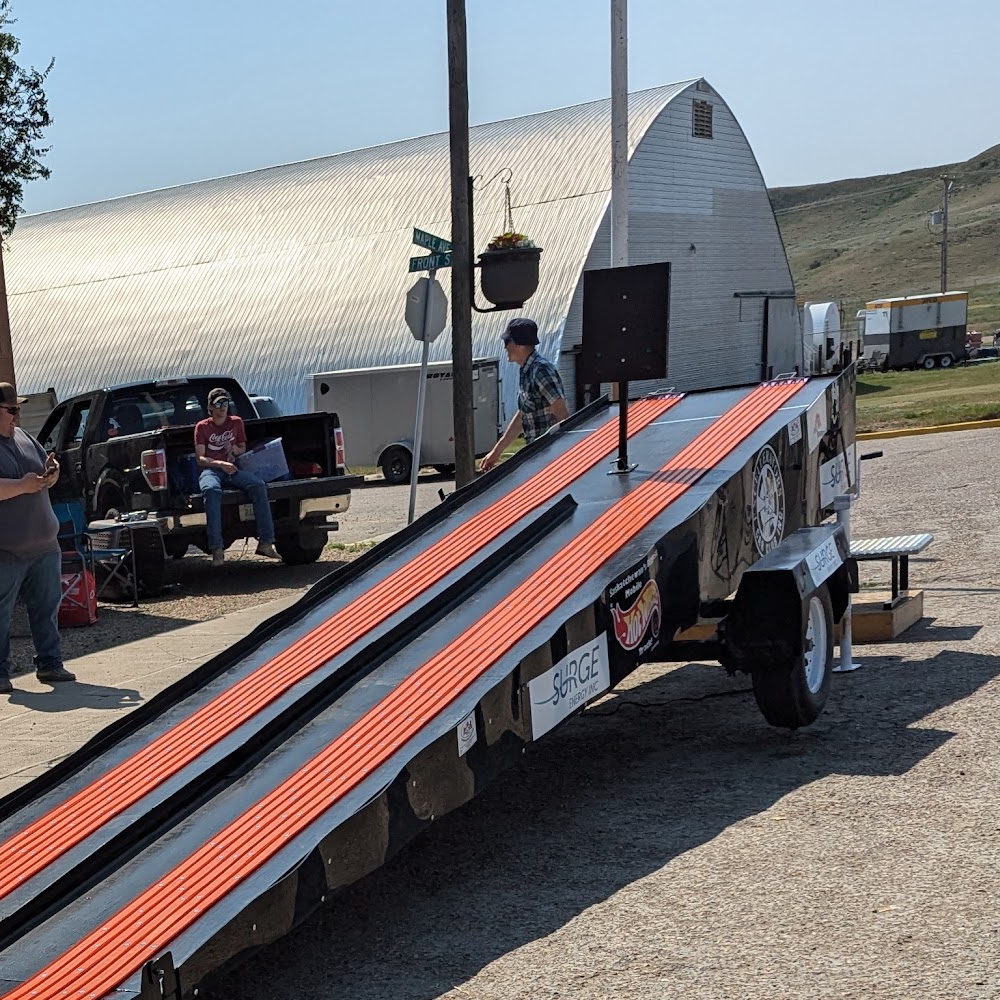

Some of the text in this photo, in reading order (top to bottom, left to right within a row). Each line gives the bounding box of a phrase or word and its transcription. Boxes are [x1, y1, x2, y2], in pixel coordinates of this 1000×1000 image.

[414, 231, 451, 253] MAPLE AVE
[411, 255, 441, 270] FRONT
[426, 372, 453, 380] ROYA
[552, 645, 600, 706] SURGE
[568, 680, 599, 709] ENERGY INC
